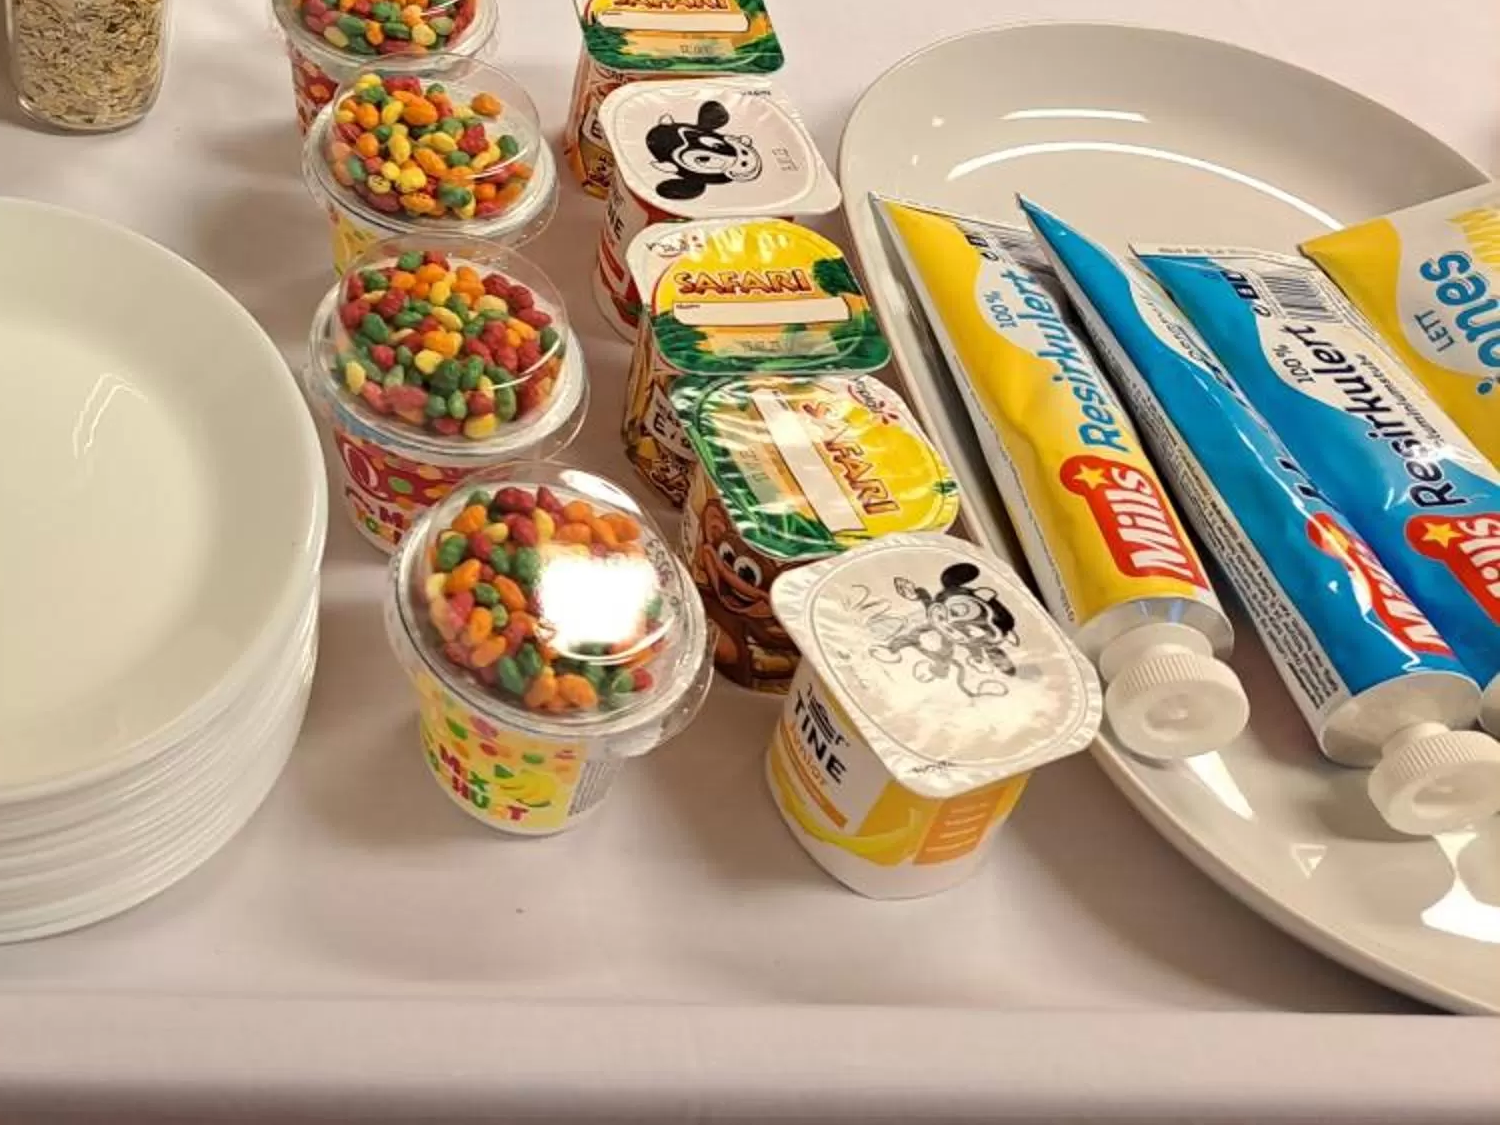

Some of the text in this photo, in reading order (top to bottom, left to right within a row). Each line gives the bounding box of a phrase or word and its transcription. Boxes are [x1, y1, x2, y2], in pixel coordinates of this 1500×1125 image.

[674, 268, 813, 295] SAFARI
[1001, 269, 1131, 453] Resirkulert
[1282, 356, 1317, 384] 100
[1414, 309, 1455, 352] LETT
[1283, 325, 1468, 508] Resirkulert
[1104, 466, 1194, 579] Mills
[794, 689, 848, 785] TINE
